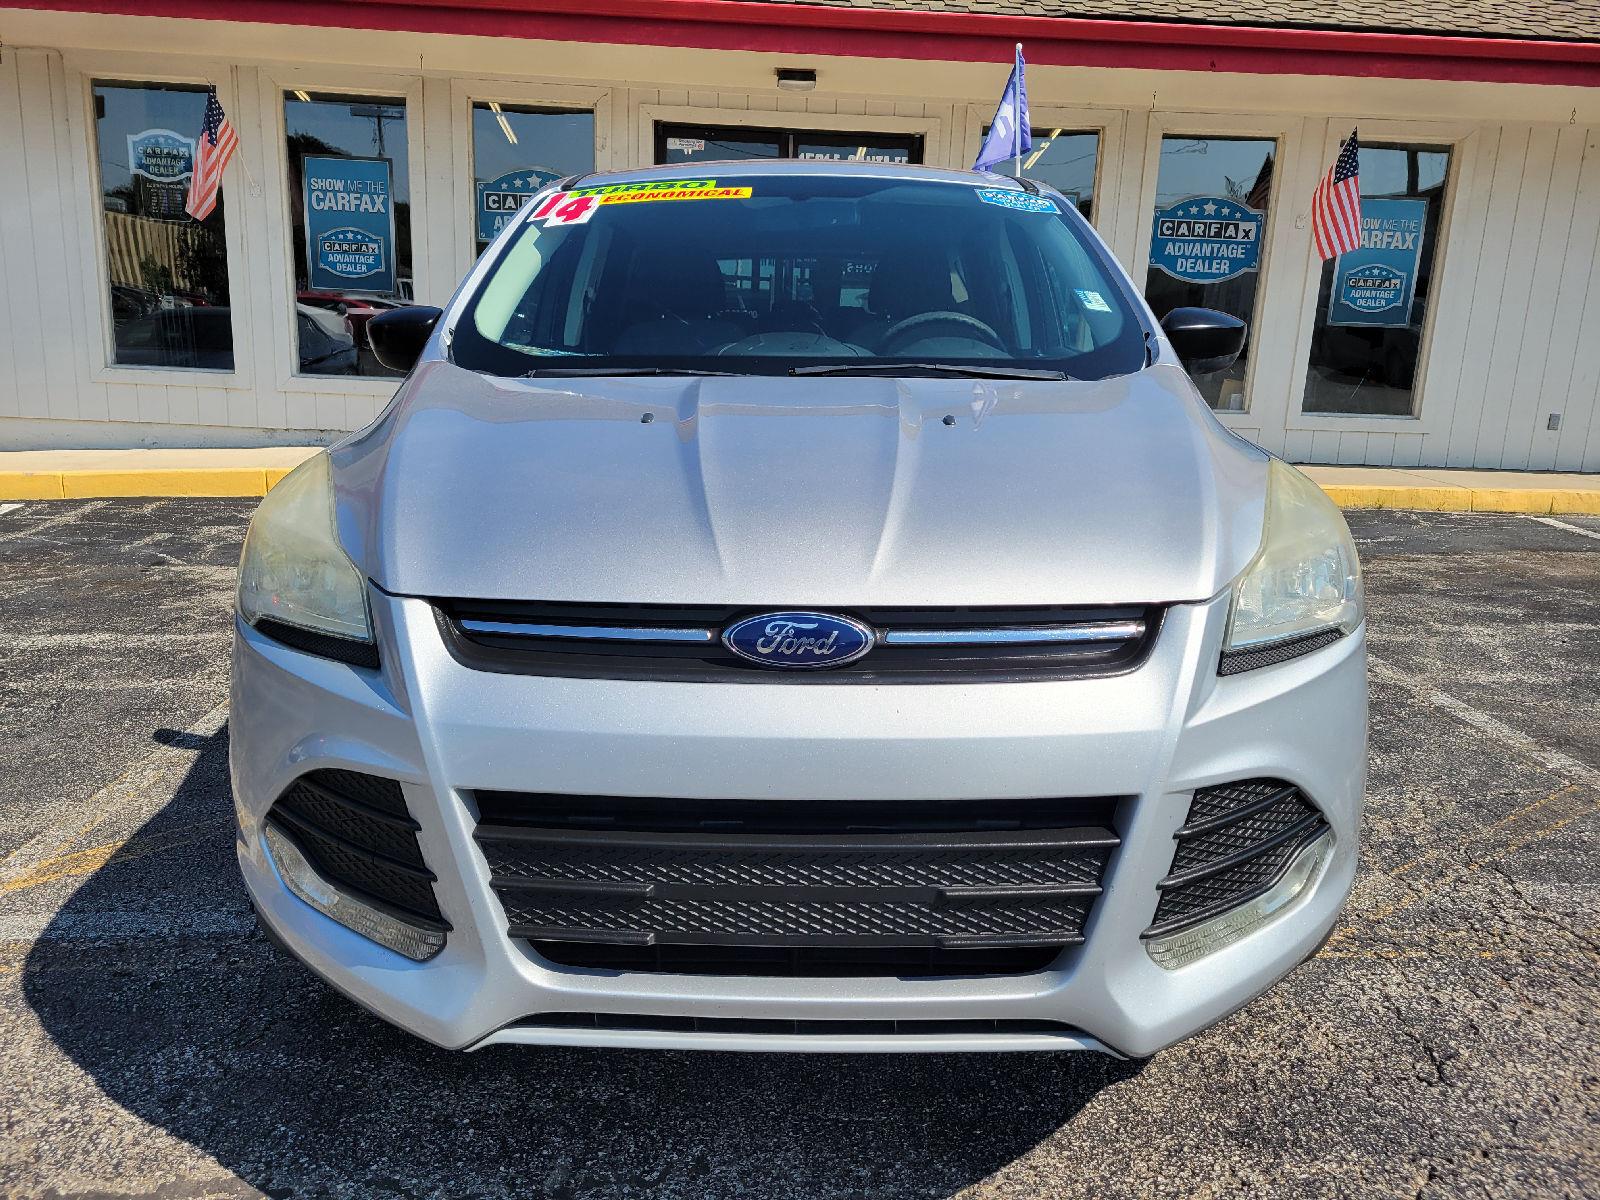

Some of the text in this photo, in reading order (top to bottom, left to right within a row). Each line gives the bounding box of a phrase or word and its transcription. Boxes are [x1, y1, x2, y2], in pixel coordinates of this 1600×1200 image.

[137, 146, 189, 157] CARFAX
[142, 157, 185, 167] ADVANTAGE
[149, 166, 179, 174] DEALER
[311, 178, 385, 193] SHOW ME THE
[311, 191, 385, 213] CARFAX
[603, 188, 746, 203] ECONOMICAL
[533, 192, 595, 223] 14
[1162, 221, 1253, 240] CARFAX
[1382, 219, 1398, 231] ME
[1400, 219, 1419, 232] THE
[1359, 231, 1416, 250] ARFAX
[323, 241, 378, 254] CARFAX
[1164, 241, 1246, 258] ADVANTAGE
[328, 253, 375, 264] ADVANTAGE
[336, 263, 367, 272] DEALER
[1176, 258, 1230, 274] DEALER
[1348, 278, 1400, 289] CARFAX
[1350, 289, 1395, 299] ADVANTAGE
[1356, 298, 1386, 307] DEALER
[756, 620, 839, 655] Ford
